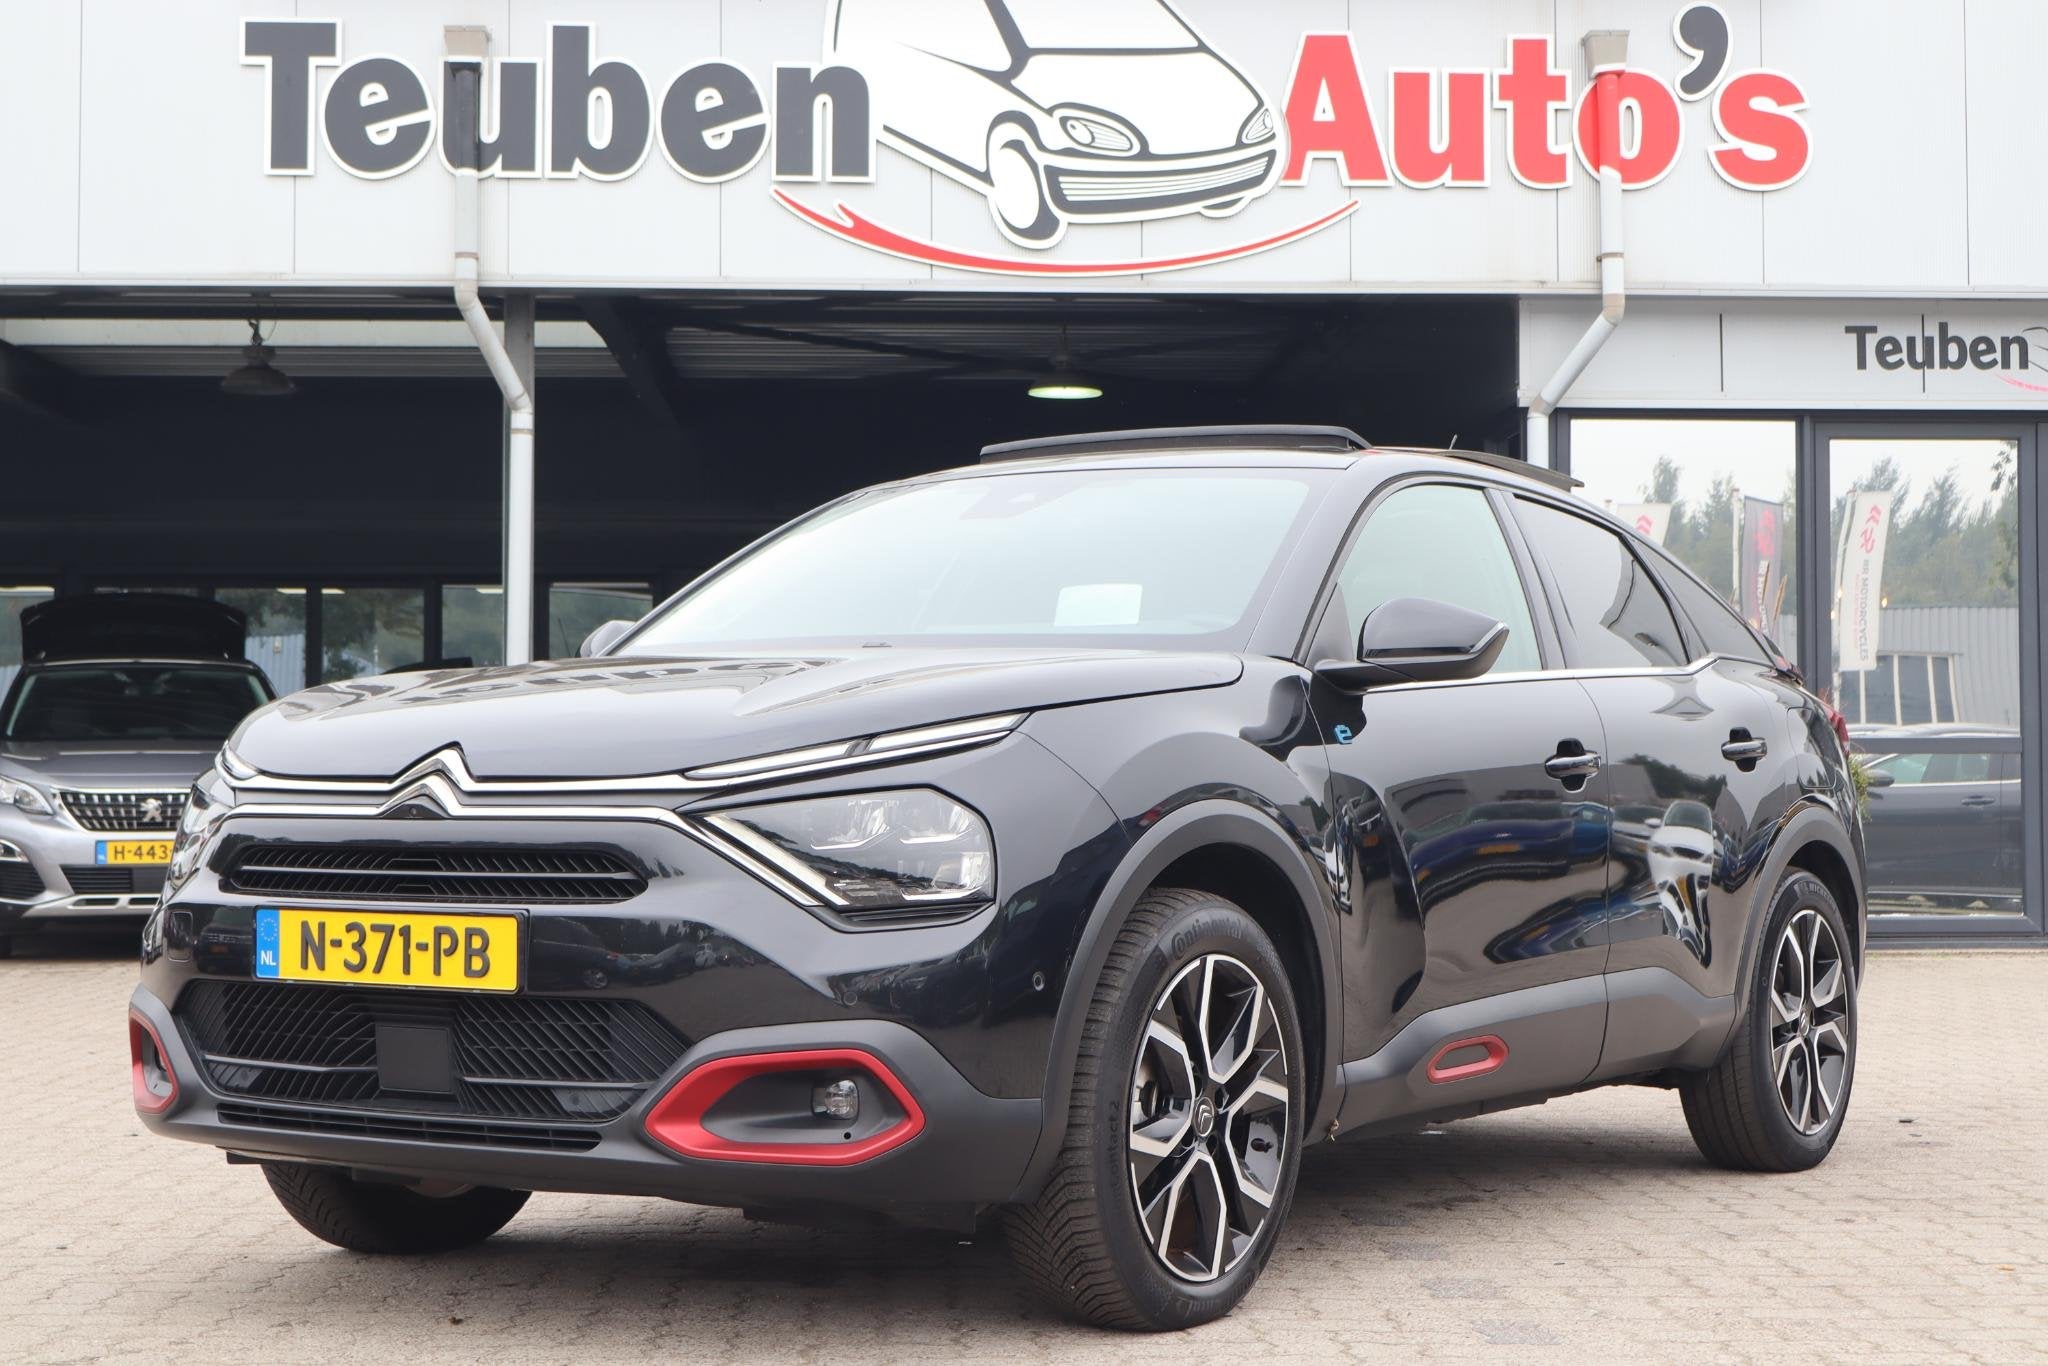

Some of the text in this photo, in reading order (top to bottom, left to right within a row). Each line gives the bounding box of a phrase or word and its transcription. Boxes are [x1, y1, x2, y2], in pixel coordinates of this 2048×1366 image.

[243, 4, 1811, 188] Teuben Auto's
[1844, 321, 2029, 370] Teuben
[261, 950, 276, 966] NL
[300, 920, 490, 978] N-371-PB
